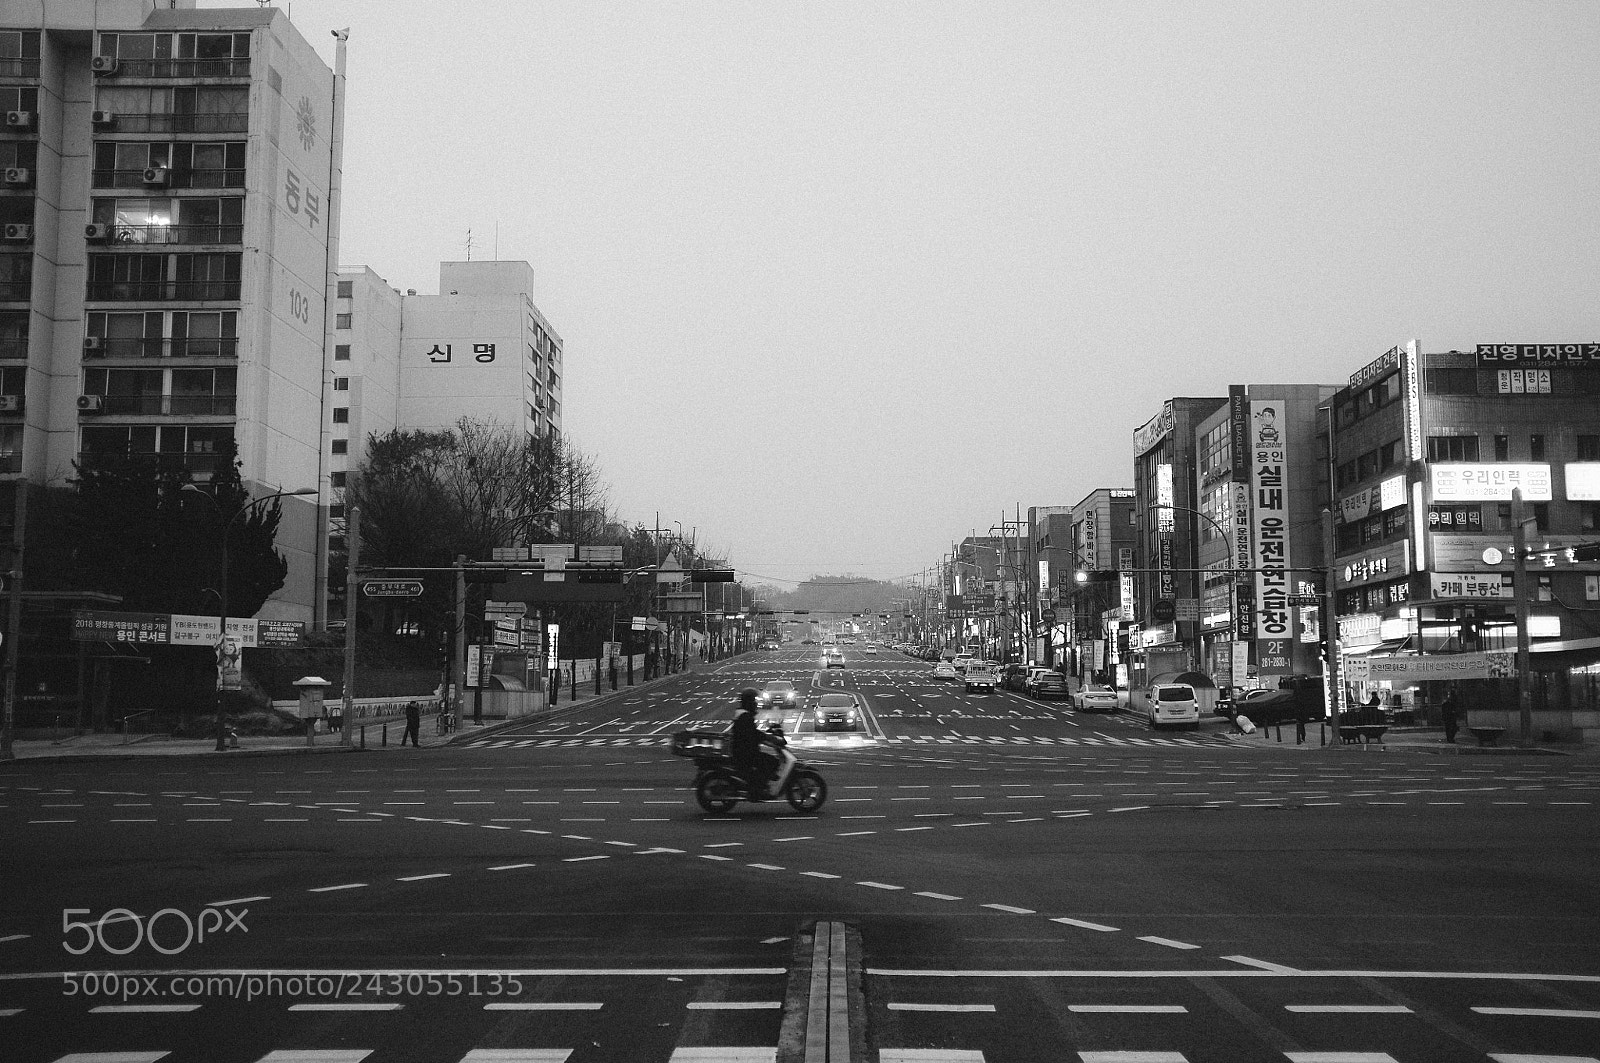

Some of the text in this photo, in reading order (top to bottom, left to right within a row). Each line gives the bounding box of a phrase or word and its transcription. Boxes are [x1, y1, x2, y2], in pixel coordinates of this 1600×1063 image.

[285, 169, 319, 228] 동부
[290, 288, 308, 324] 103
[1480, 345, 1518, 360] 진영
[1523, 345, 1583, 360] 디자인
[1234, 395, 1244, 469] PARIS BAGUETTE
[1257, 451, 1283, 463] 용인
[1462, 470, 1520, 485] 우리인력
[1257, 465, 1285, 510] 실내
[1258, 517, 1291, 634] 운전연습장
[1467, 582, 1500, 596] 부동산
[75, 619, 93, 628] 2018
[154, 623, 167, 631] 기원
[116, 630, 167, 642] 용인 콘서트
[1268, 641, 1284, 654] 2F
